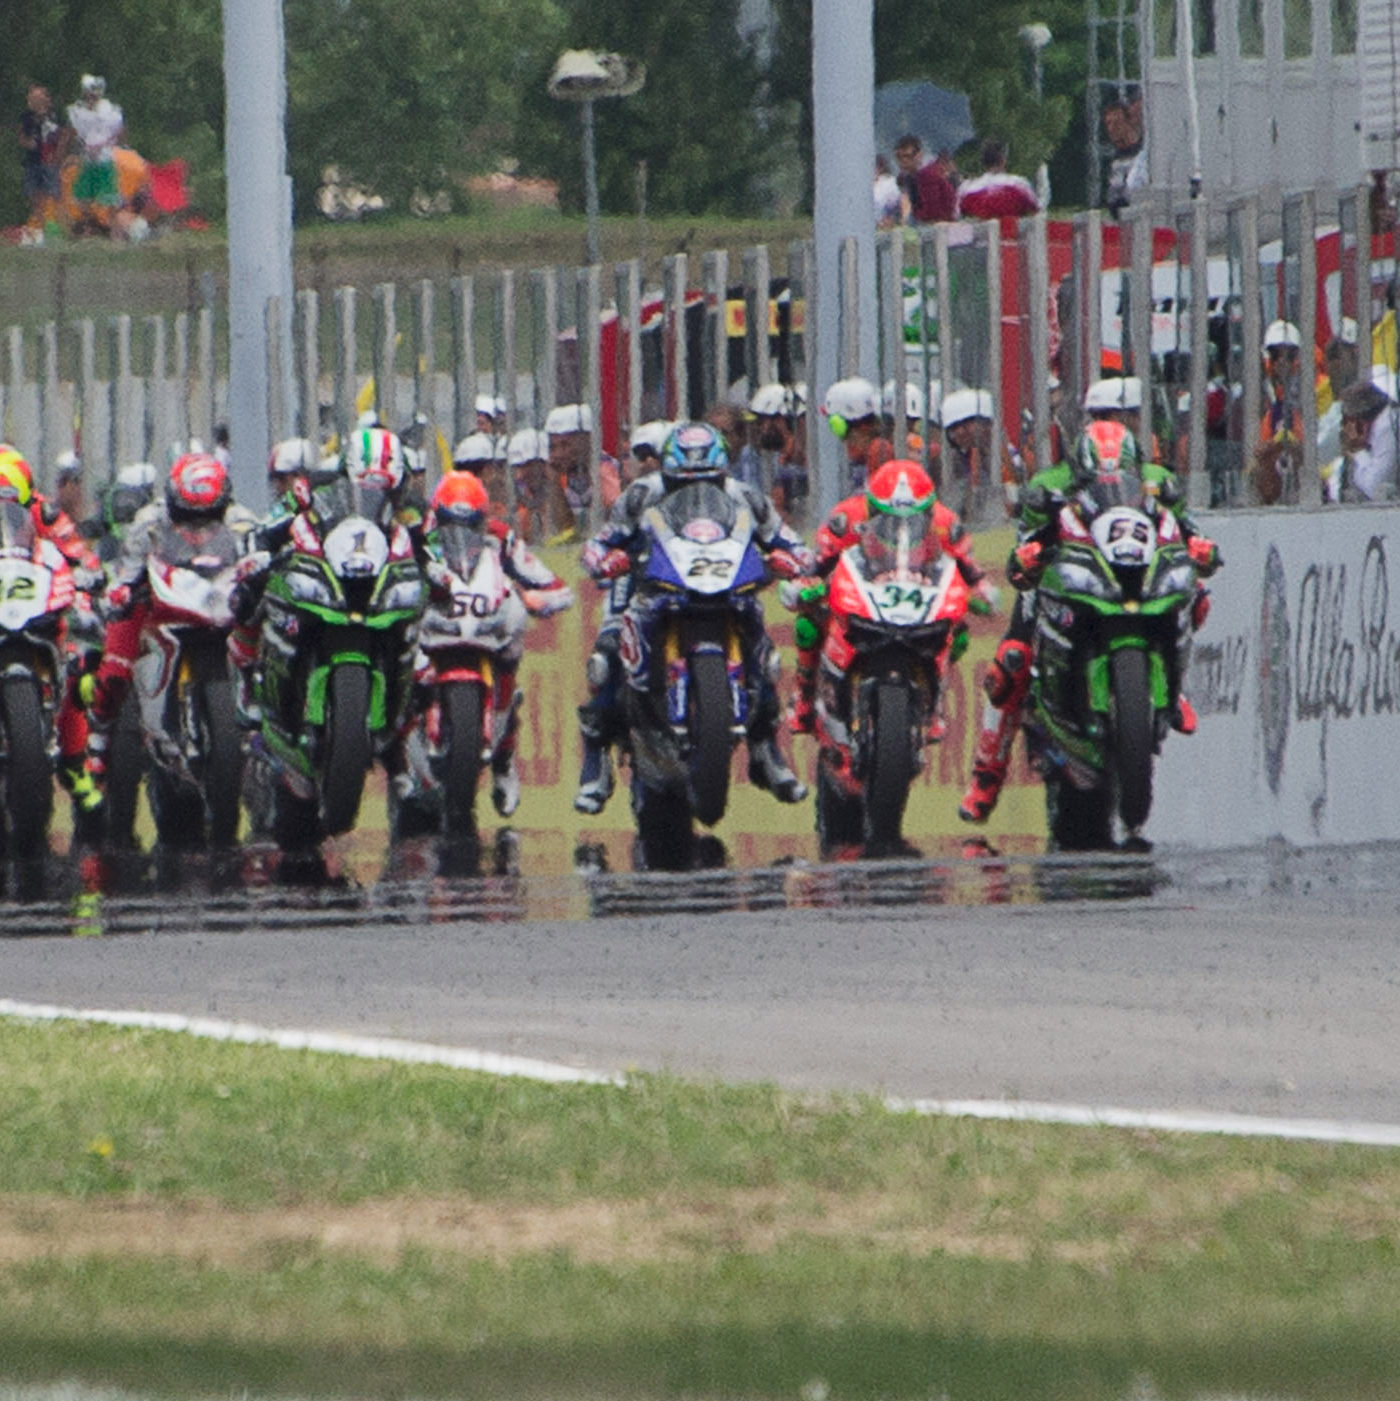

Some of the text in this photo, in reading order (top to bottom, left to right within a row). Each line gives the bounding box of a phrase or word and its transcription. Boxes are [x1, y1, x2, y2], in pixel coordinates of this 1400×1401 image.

[352, 529, 367, 554] 1
[687, 556, 733, 578] 22
[879, 584, 928, 610] 34
